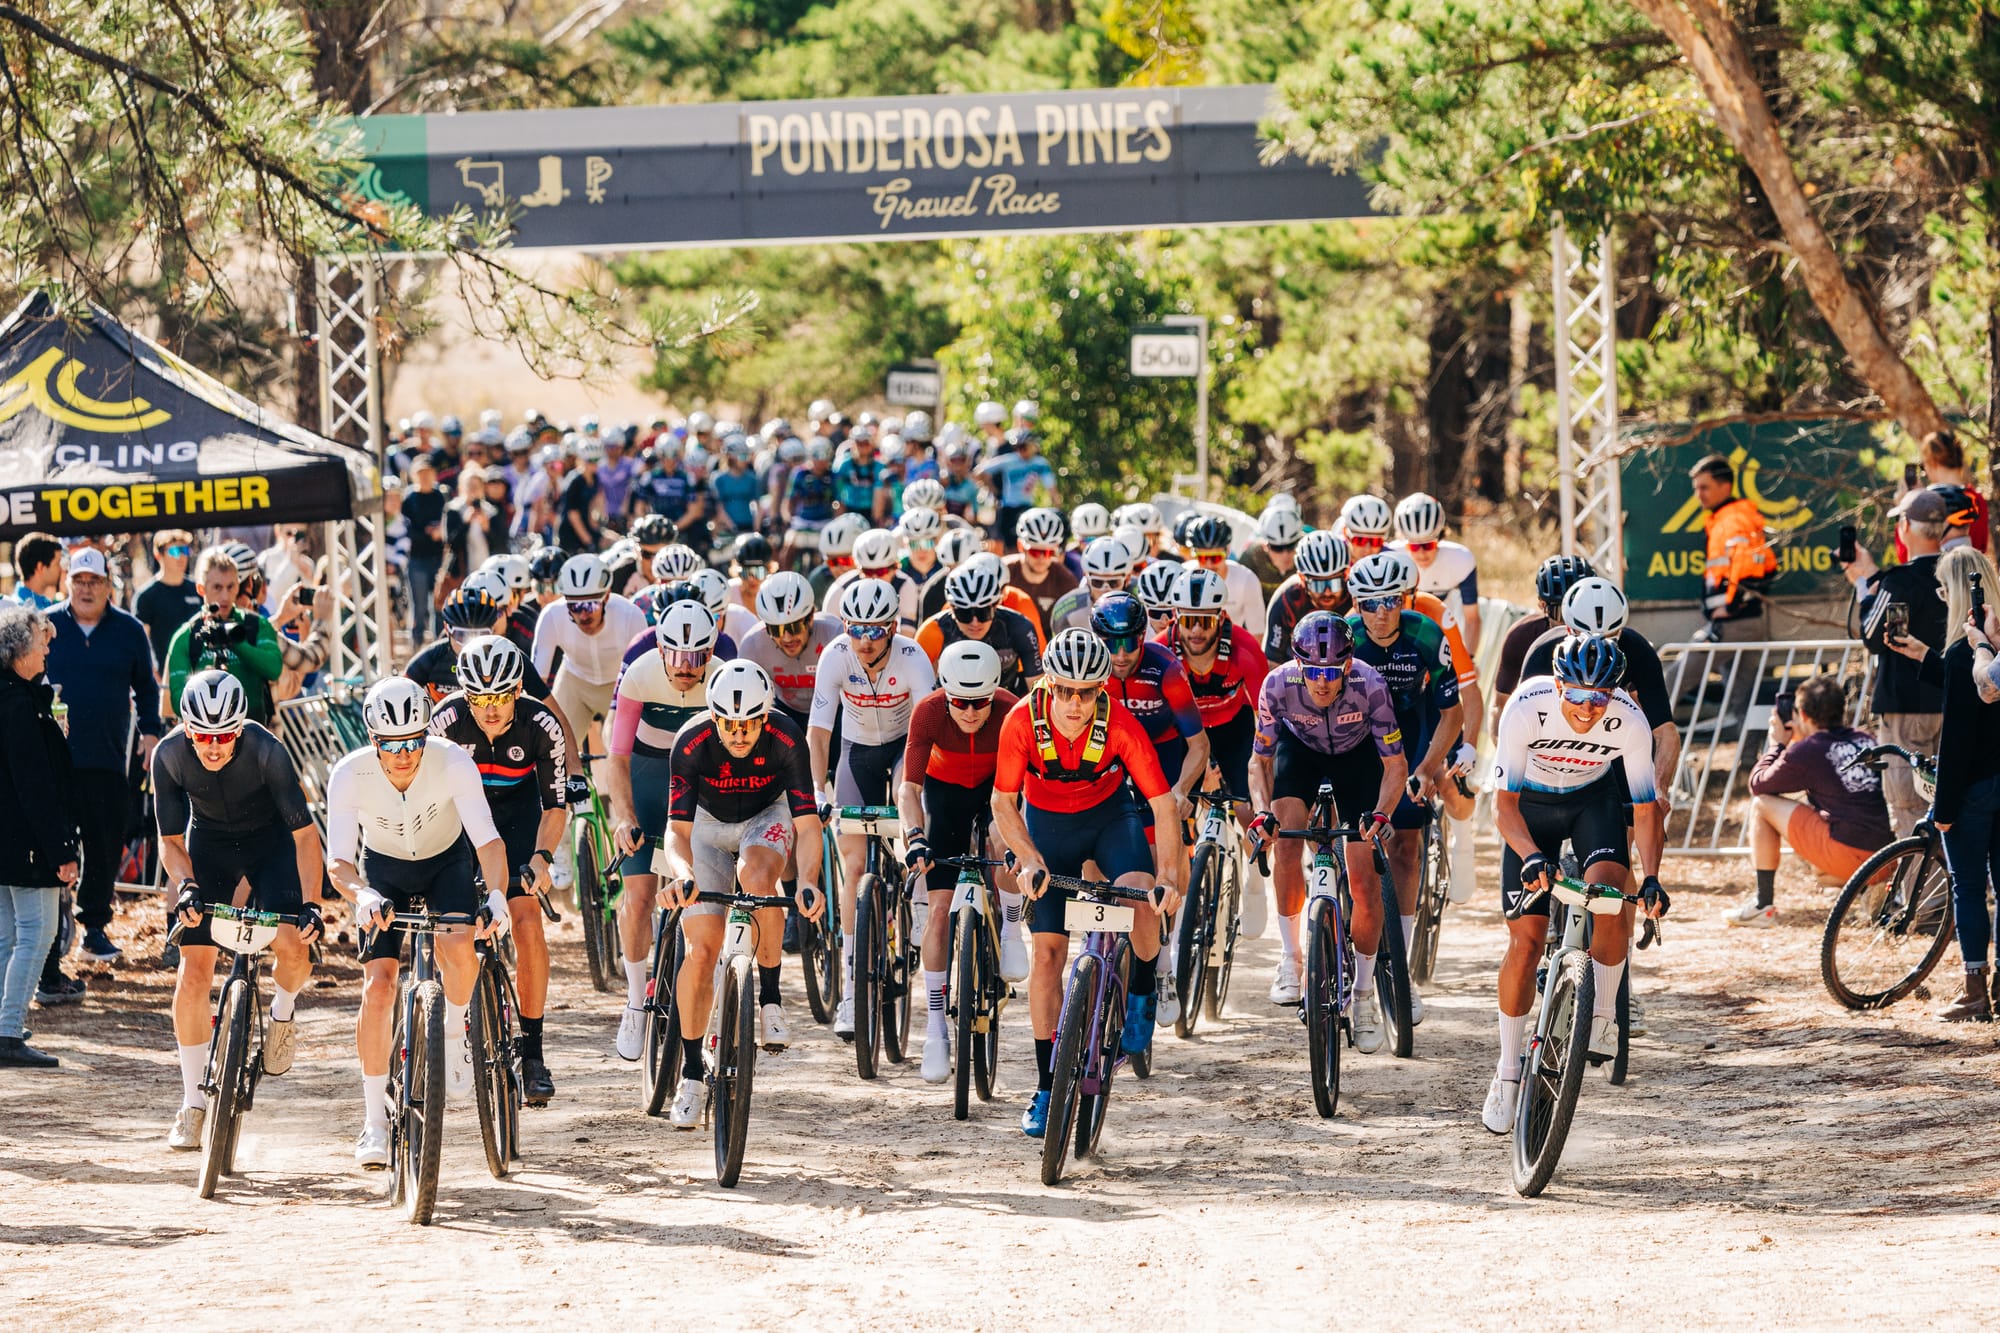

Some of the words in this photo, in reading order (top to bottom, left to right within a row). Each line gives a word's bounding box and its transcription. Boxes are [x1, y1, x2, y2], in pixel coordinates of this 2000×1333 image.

[749, 105, 1024, 177] PONDEROSA
[1037, 99, 1173, 167] PINES
[867, 177, 978, 229] Gravel
[985, 174, 1060, 217] Race
[41, 476, 271, 523] TOGETHER
[1648, 545, 1832, 577] AUSING
[1530, 689, 1552, 697] KENDA
[1528, 739, 1621, 755] GIANT
[862, 823, 878, 834] 11
[1205, 820, 1221, 836] 21
[1318, 869, 1328, 887] 2
[965, 886, 975, 904] 4
[1095, 905, 1105, 922] 3
[236, 925, 254, 945] 14
[735, 925, 745, 944] 7
